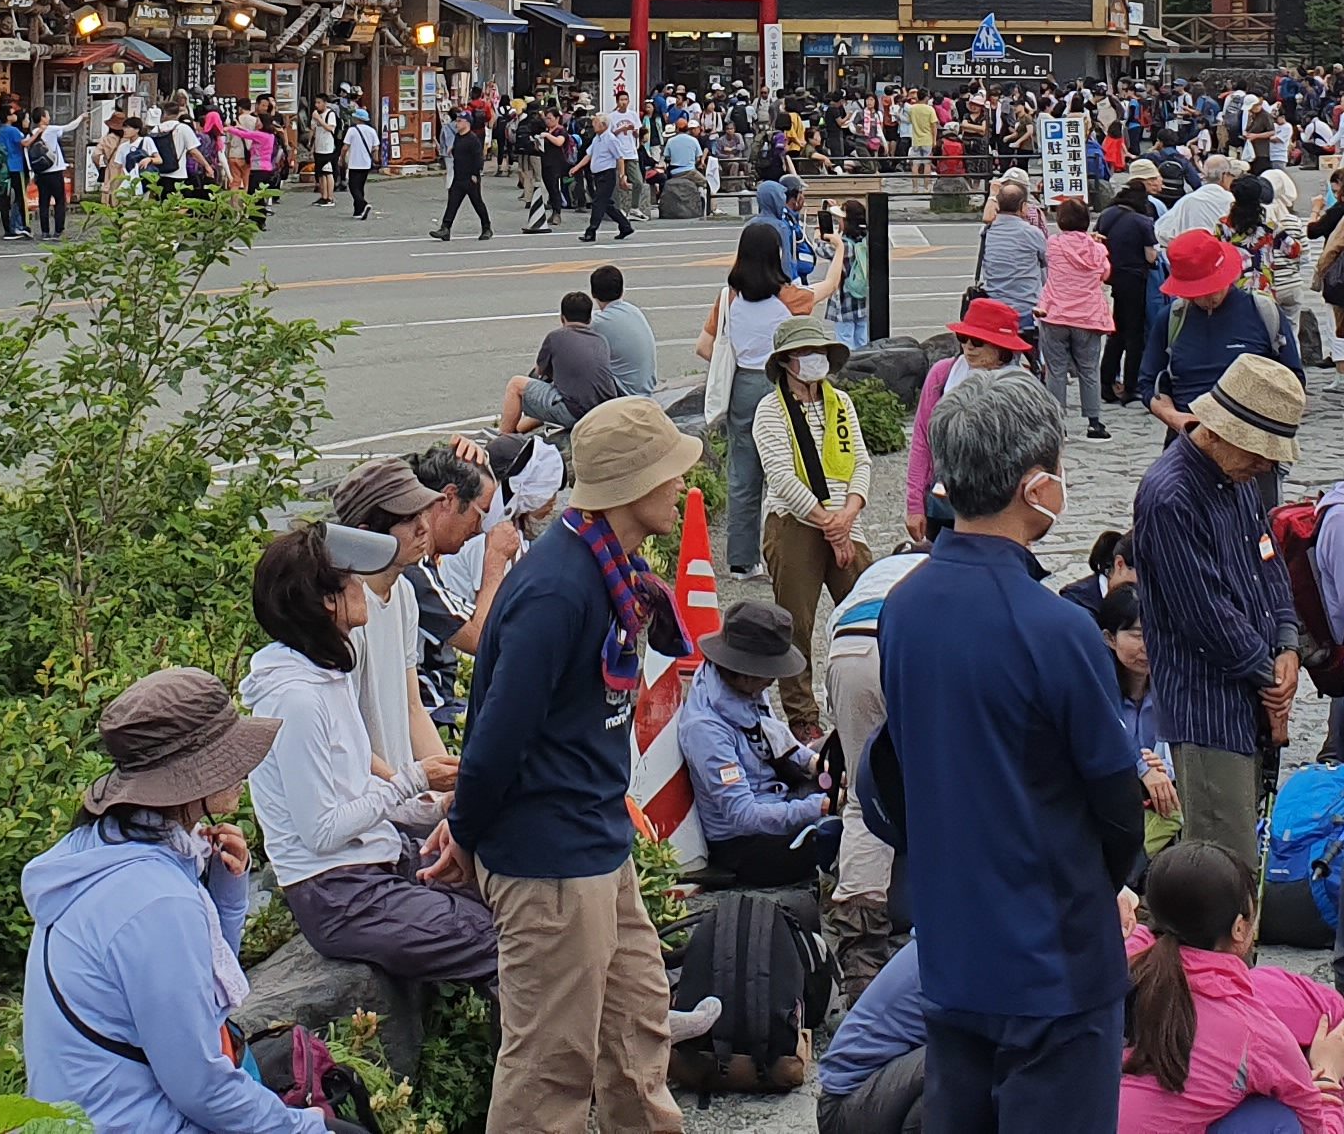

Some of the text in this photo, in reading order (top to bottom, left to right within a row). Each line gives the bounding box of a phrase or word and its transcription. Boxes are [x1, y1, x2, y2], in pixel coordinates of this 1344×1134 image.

[1065, 120, 1083, 193] 普通車専用
